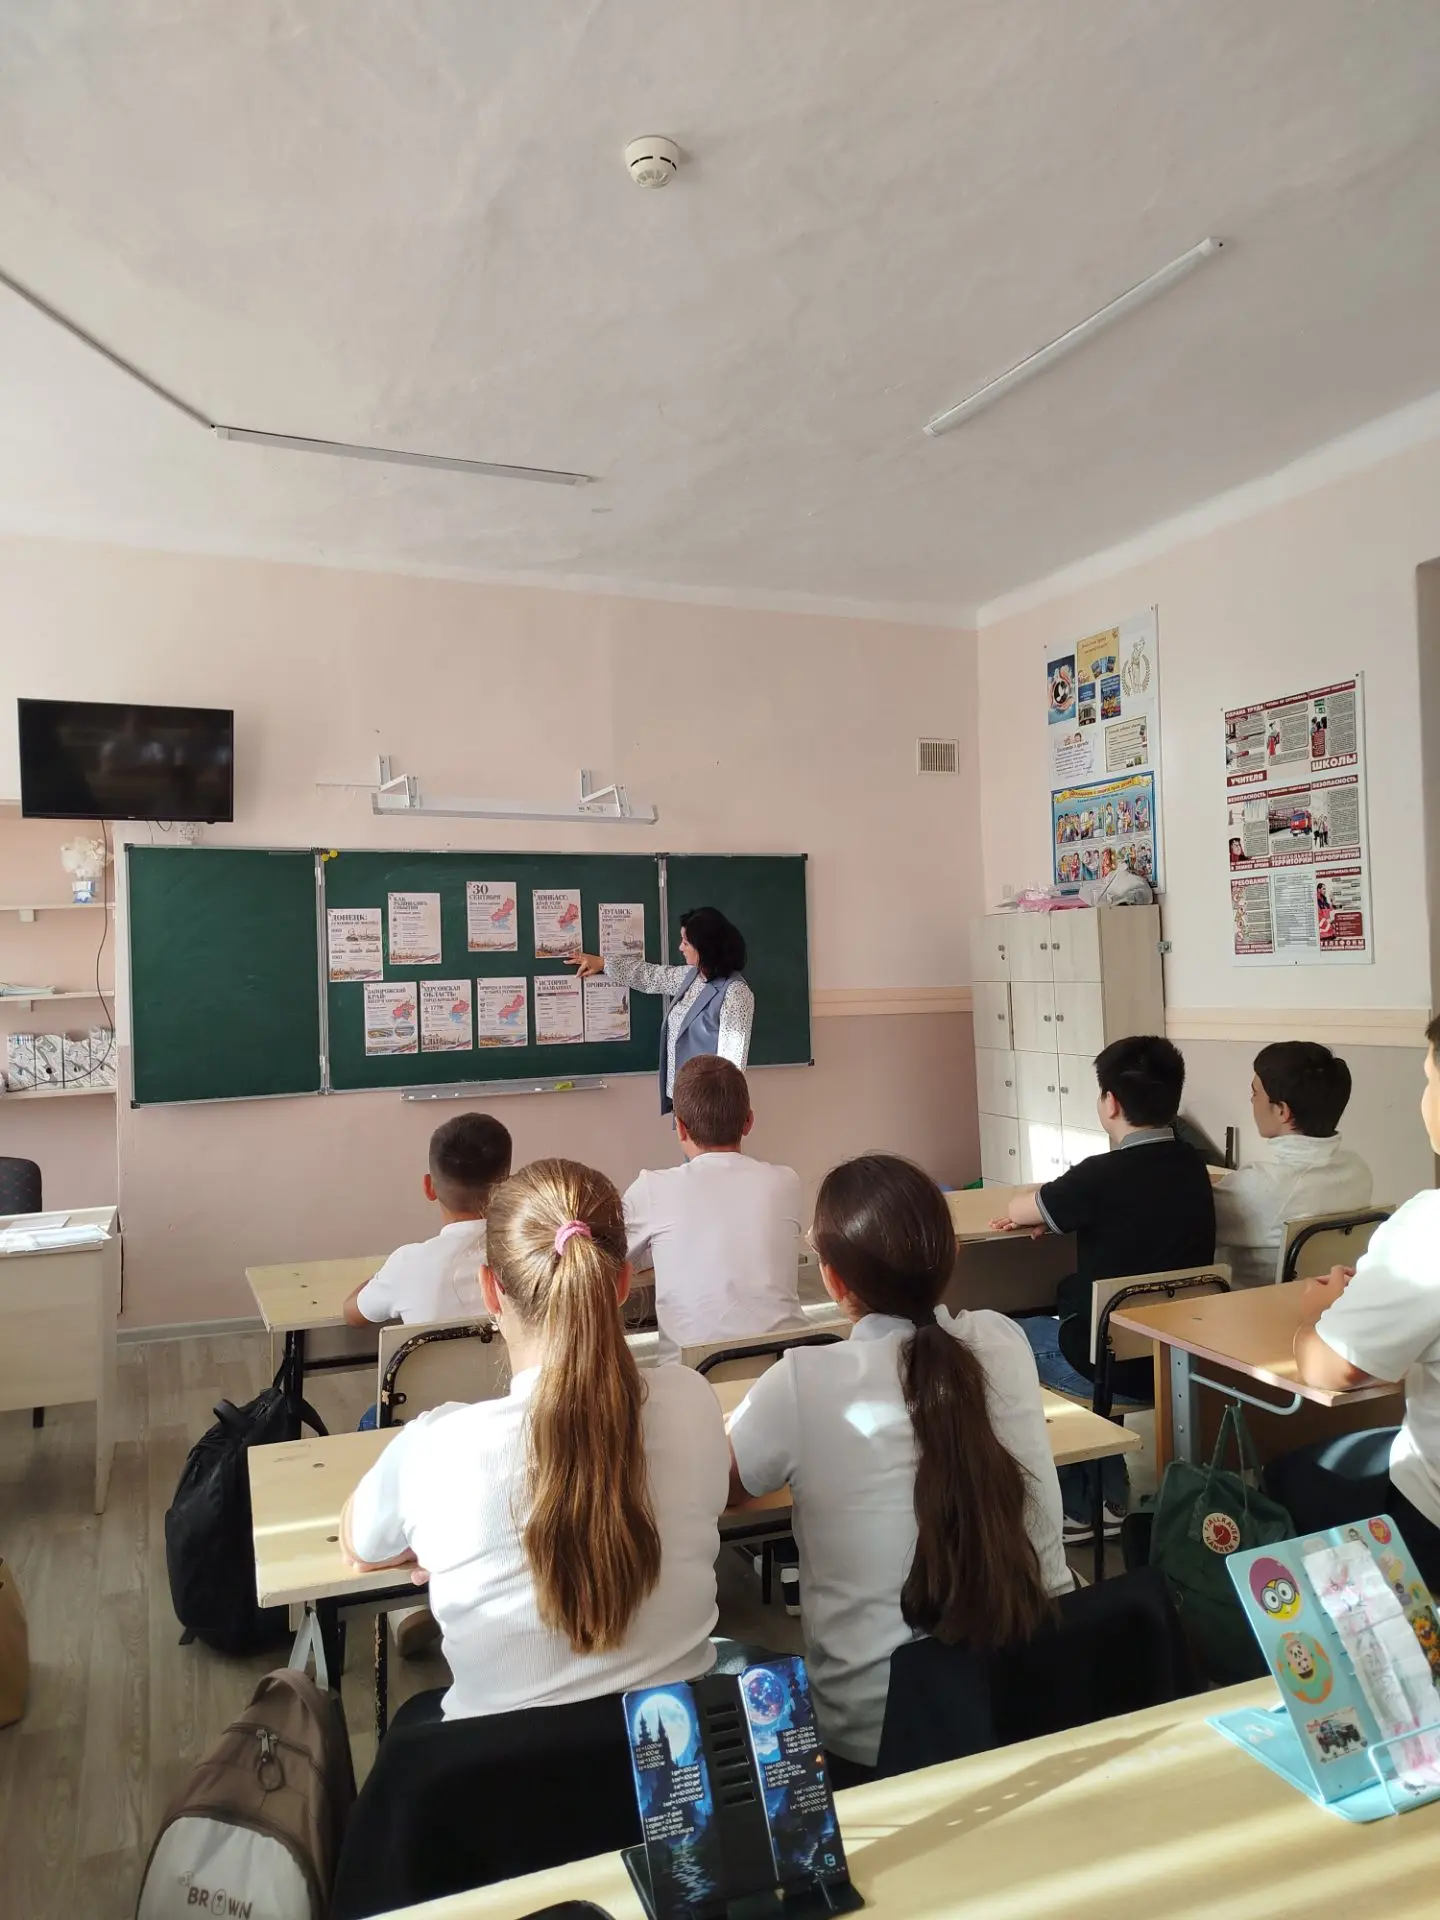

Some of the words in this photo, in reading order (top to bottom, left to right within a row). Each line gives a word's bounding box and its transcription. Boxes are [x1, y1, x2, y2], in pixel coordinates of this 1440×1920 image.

[1312, 755, 1357, 770] ШКОЛЫ
[1231, 773, 1264, 785] УЧИТЕЛЯ
[1312, 776, 1357, 788] БЕЗОПАСНОСТЬ
[1271, 857, 1313, 867] ТЕРРИТОРИИ
[472, 883, 489, 895] 30
